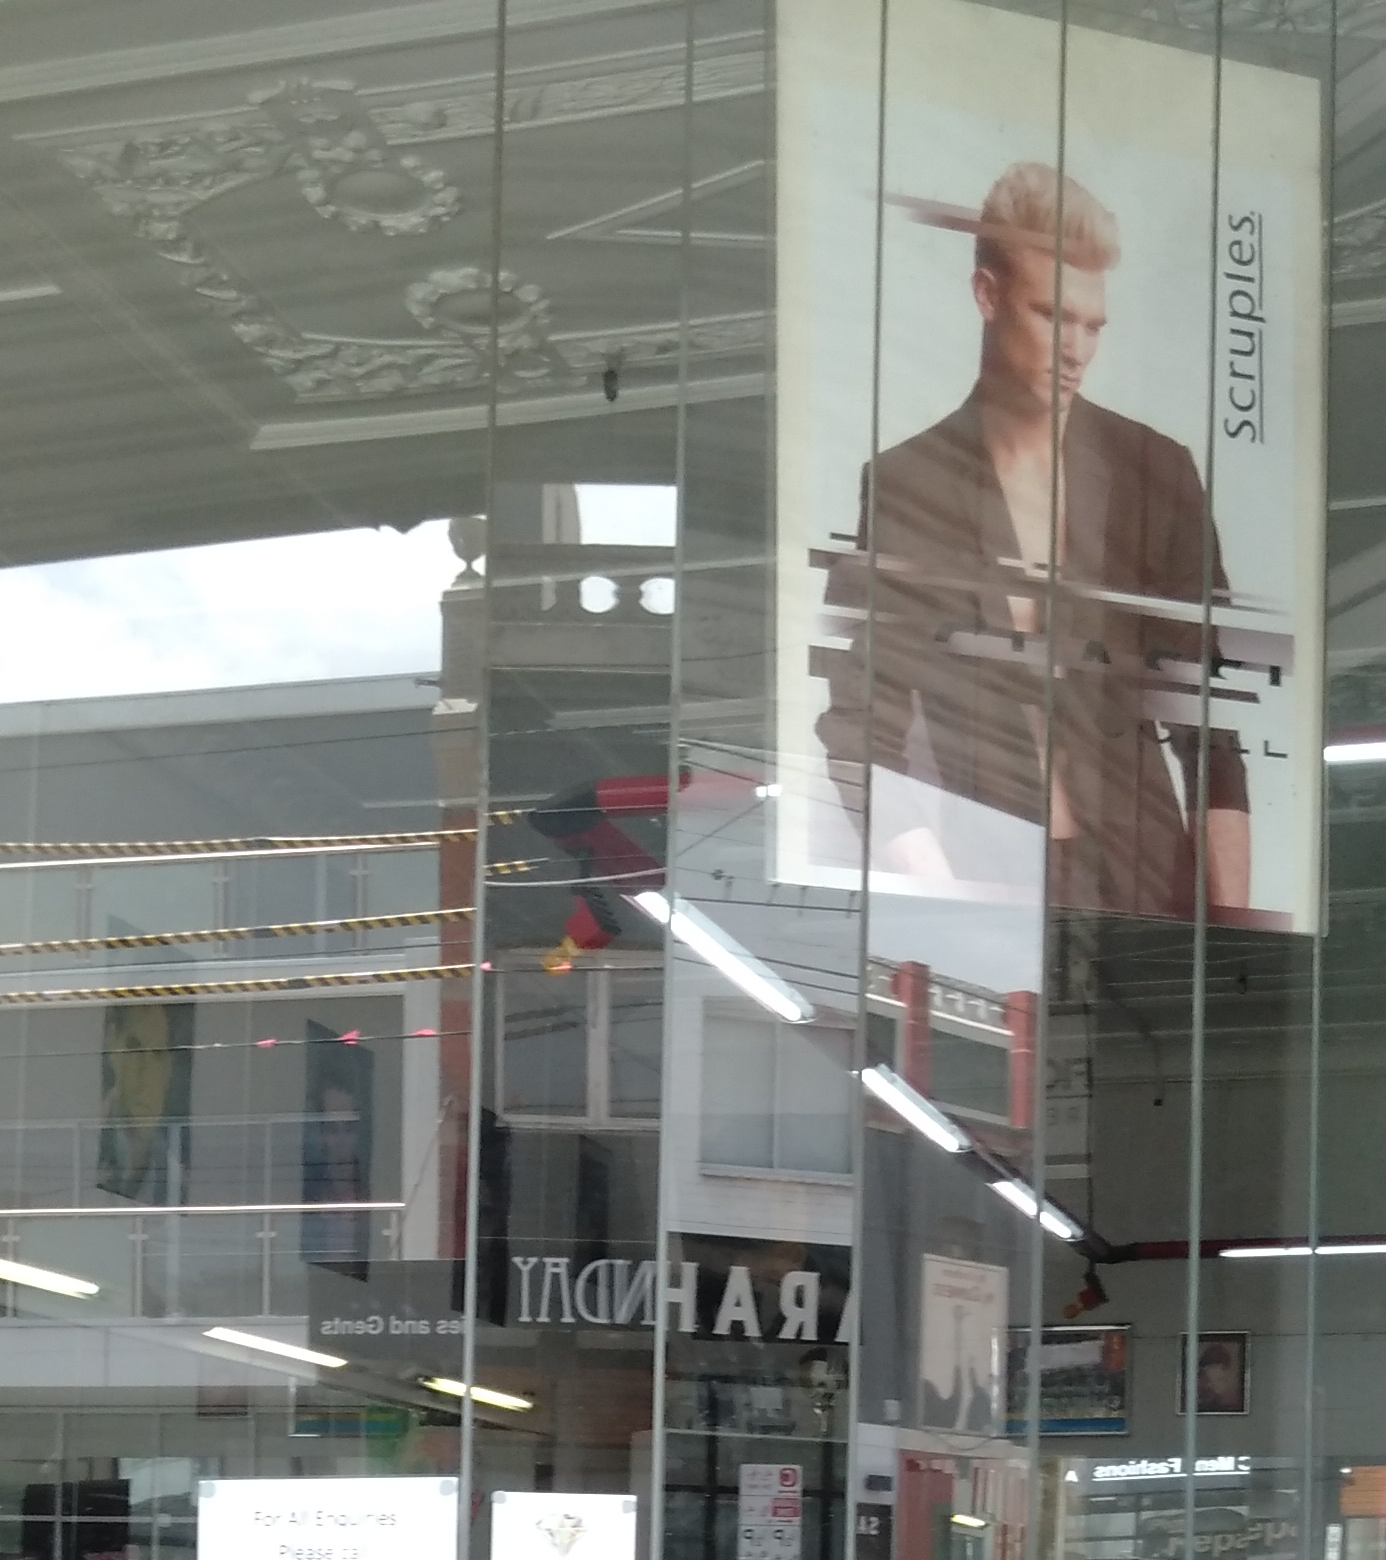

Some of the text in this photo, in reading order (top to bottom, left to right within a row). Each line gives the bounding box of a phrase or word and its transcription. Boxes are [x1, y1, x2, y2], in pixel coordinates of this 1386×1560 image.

[1223, 213, 1266, 444] Scruples
[254, 1510, 281, 1526] For
[279, 1545, 334, 1560] Please
